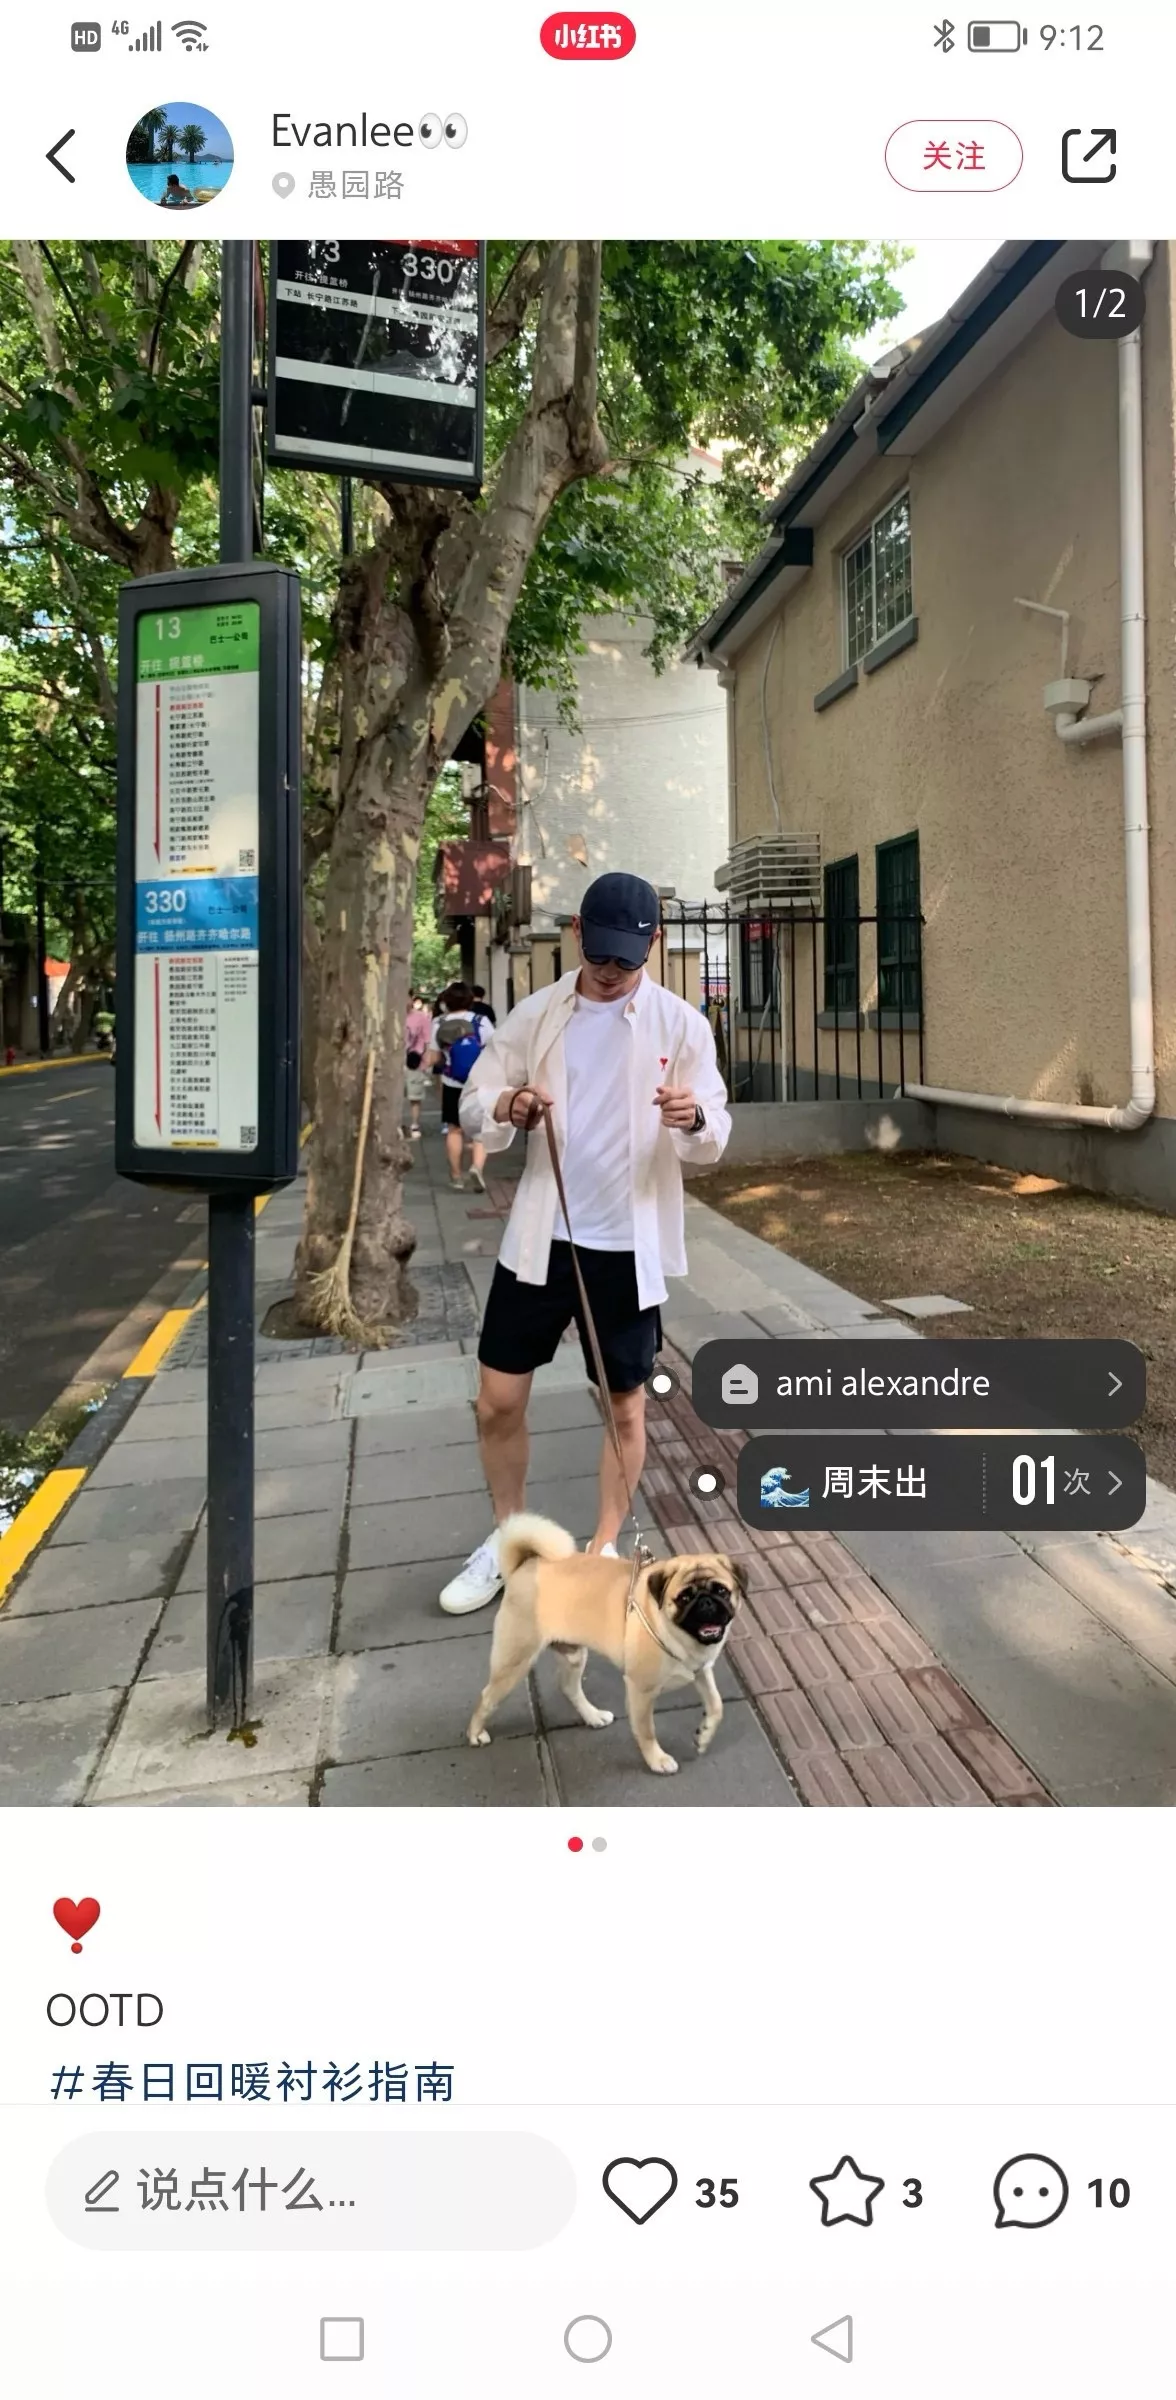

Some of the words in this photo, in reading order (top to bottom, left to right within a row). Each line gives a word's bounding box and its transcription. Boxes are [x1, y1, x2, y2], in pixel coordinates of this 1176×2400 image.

[402, 252, 454, 284] 330
[284, 287, 302, 298] 下站
[306, 291, 358, 308] 长宁路江苏路
[155, 616, 181, 640] 13
[209, 632, 248, 644] 巴士一公司
[145, 889, 186, 914] 330
[208, 905, 247, 915] 巴士一公司
